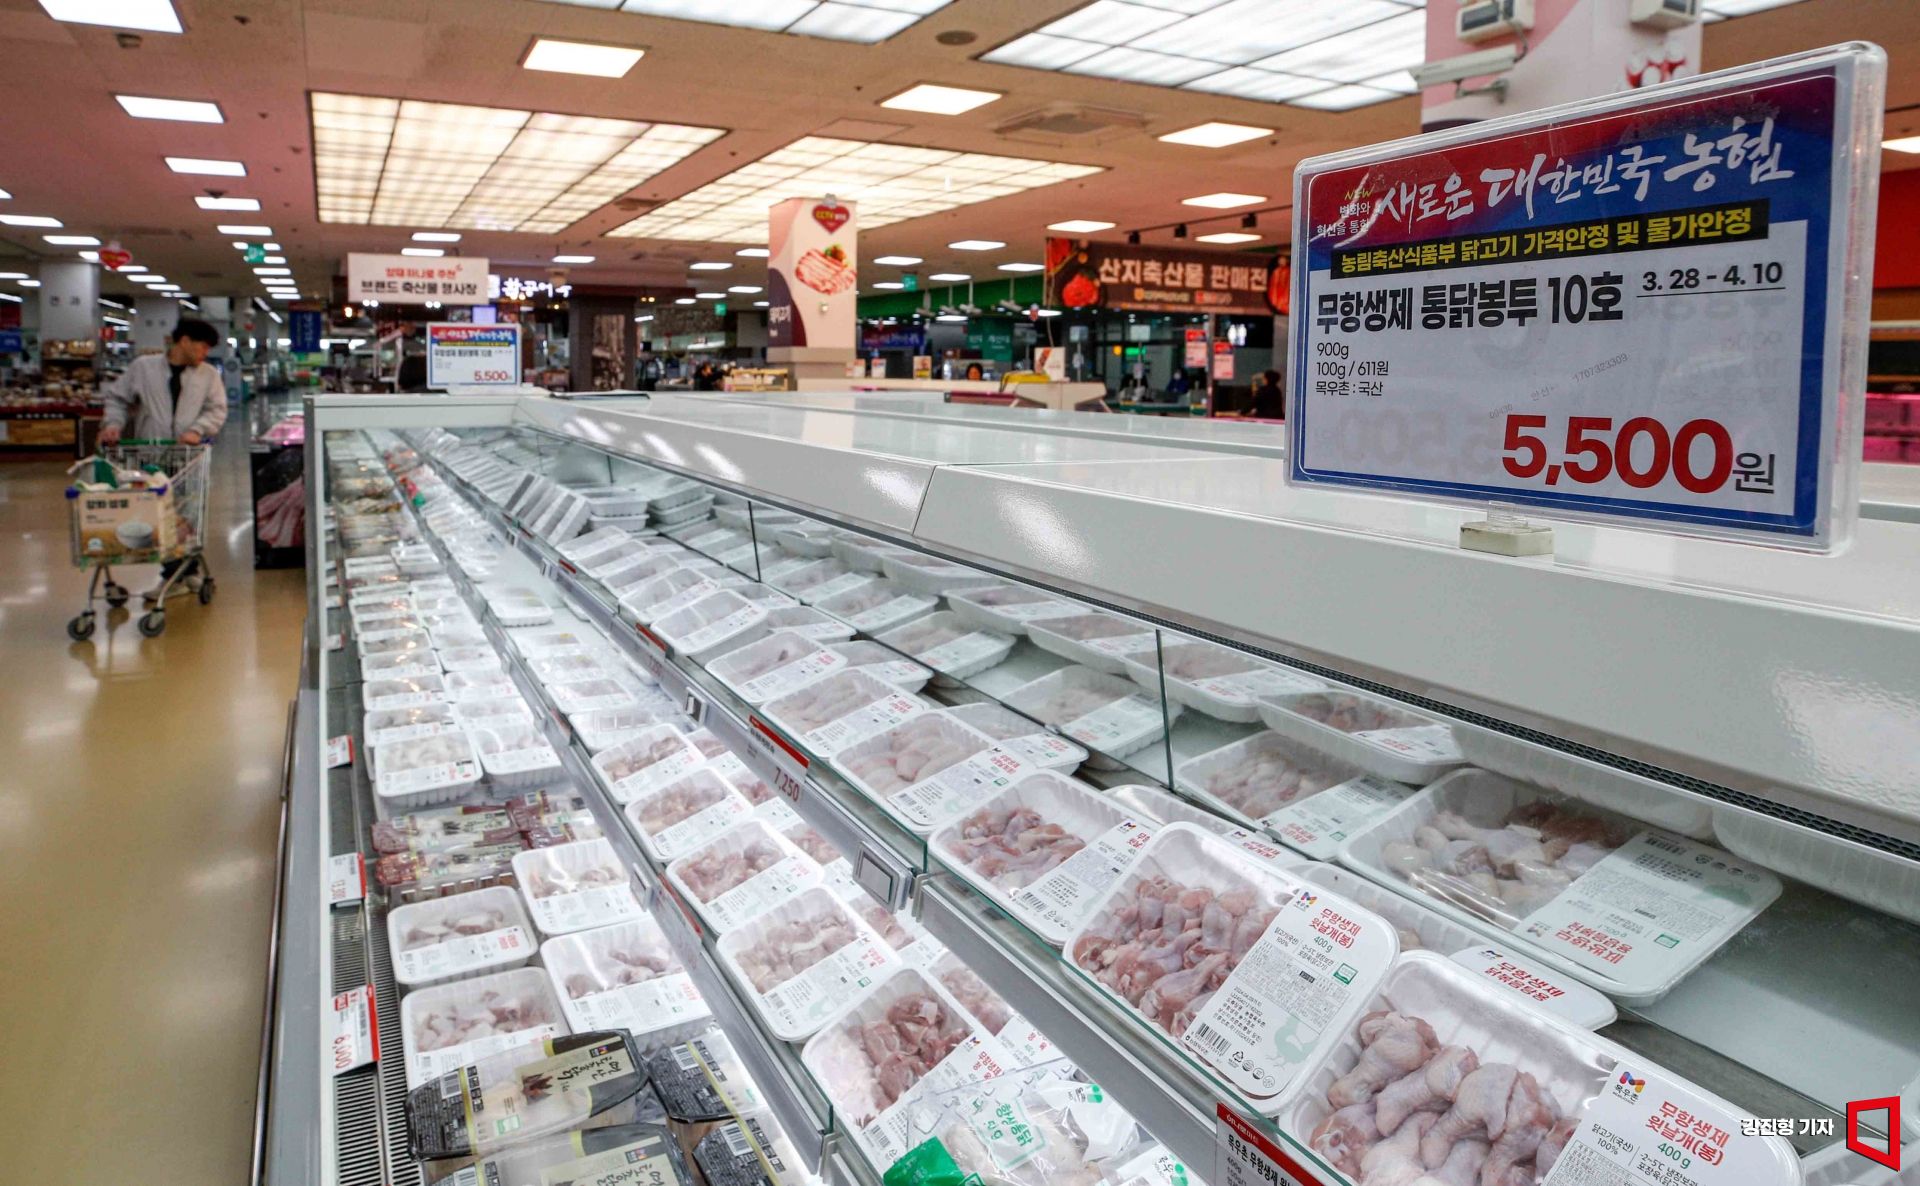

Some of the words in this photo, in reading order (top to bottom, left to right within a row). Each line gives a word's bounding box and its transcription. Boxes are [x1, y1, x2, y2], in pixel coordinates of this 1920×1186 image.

[1380, 171, 1474, 234] 새로운
[1480, 145, 1666, 220] 대한민국
[1664, 116, 1795, 192] 농협
[1344, 184, 1373, 200] NEW
[1340, 200, 1371, 218] 변화와
[1341, 242, 1456, 274] 농림축산식품부
[1461, 235, 1517, 262] 닭고기
[1523, 224, 1609, 256] 가격안정
[1617, 221, 1640, 247] 및
[1646, 207, 1752, 243] 물가안정
[361, 281, 399, 294] 브랜드
[402, 281, 438, 294] 축산물
[1099, 257, 1204, 289] 산지축산물
[1210, 264, 1268, 292] 판매전
[1317, 287, 1413, 334] 무항생제
[1421, 278, 1538, 330] 통닭봉투
[1547, 271, 1624, 324] 10호
[1317, 342, 1349, 359] 900g
[1316, 361, 1346, 379] 100g
[1357, 360, 1389, 377] 611원
[1315, 381, 1350, 396] 목우촌
[1358, 380, 1383, 397] 국산
[774, 766, 800, 802] 7,250
[1309, 917, 1356, 949] 윗날개(봉)
[1319, 907, 1362, 936] 무항생제
[1498, 962, 1566, 997] 무항생제
[1591, 1123, 1634, 1153] 닭고기(국산)
[1659, 1101, 1731, 1148] 무항생제
[1597, 1138, 1619, 1156] 100%
[1645, 1115, 1725, 1167] 윗날개(봉)
[1657, 1142, 1682, 1159] 400
[1228, 1134, 1249, 1163] 목우촌
[1249, 1153, 1279, 1186] 무항생제
